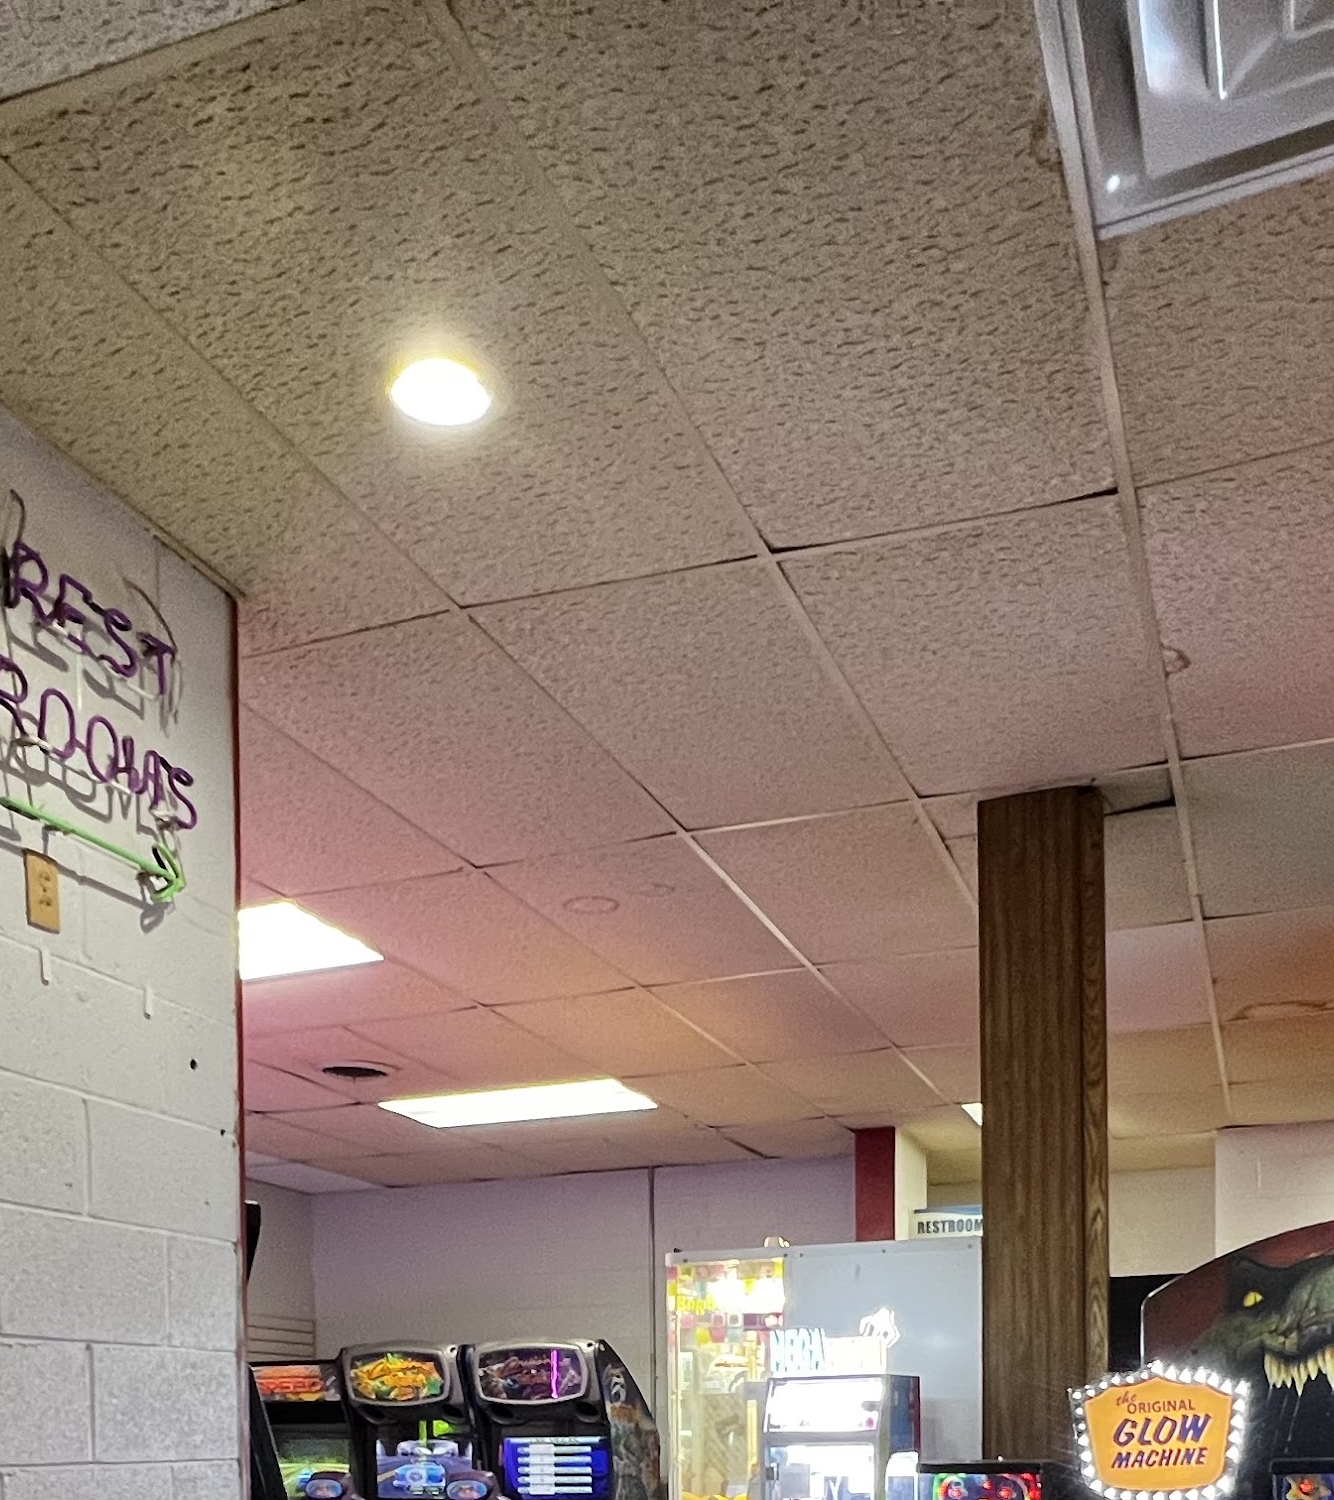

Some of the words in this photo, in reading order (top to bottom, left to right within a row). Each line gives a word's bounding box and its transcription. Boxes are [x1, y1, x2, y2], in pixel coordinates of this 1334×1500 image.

[2, 540, 176, 696] REST
[1116, 1391, 1137, 1406] the
[1127, 1399, 1196, 1414] ORIGINAL
[1113, 1413, 1212, 1447] GLOW
[1111, 1447, 1208, 1468] MACHINE
